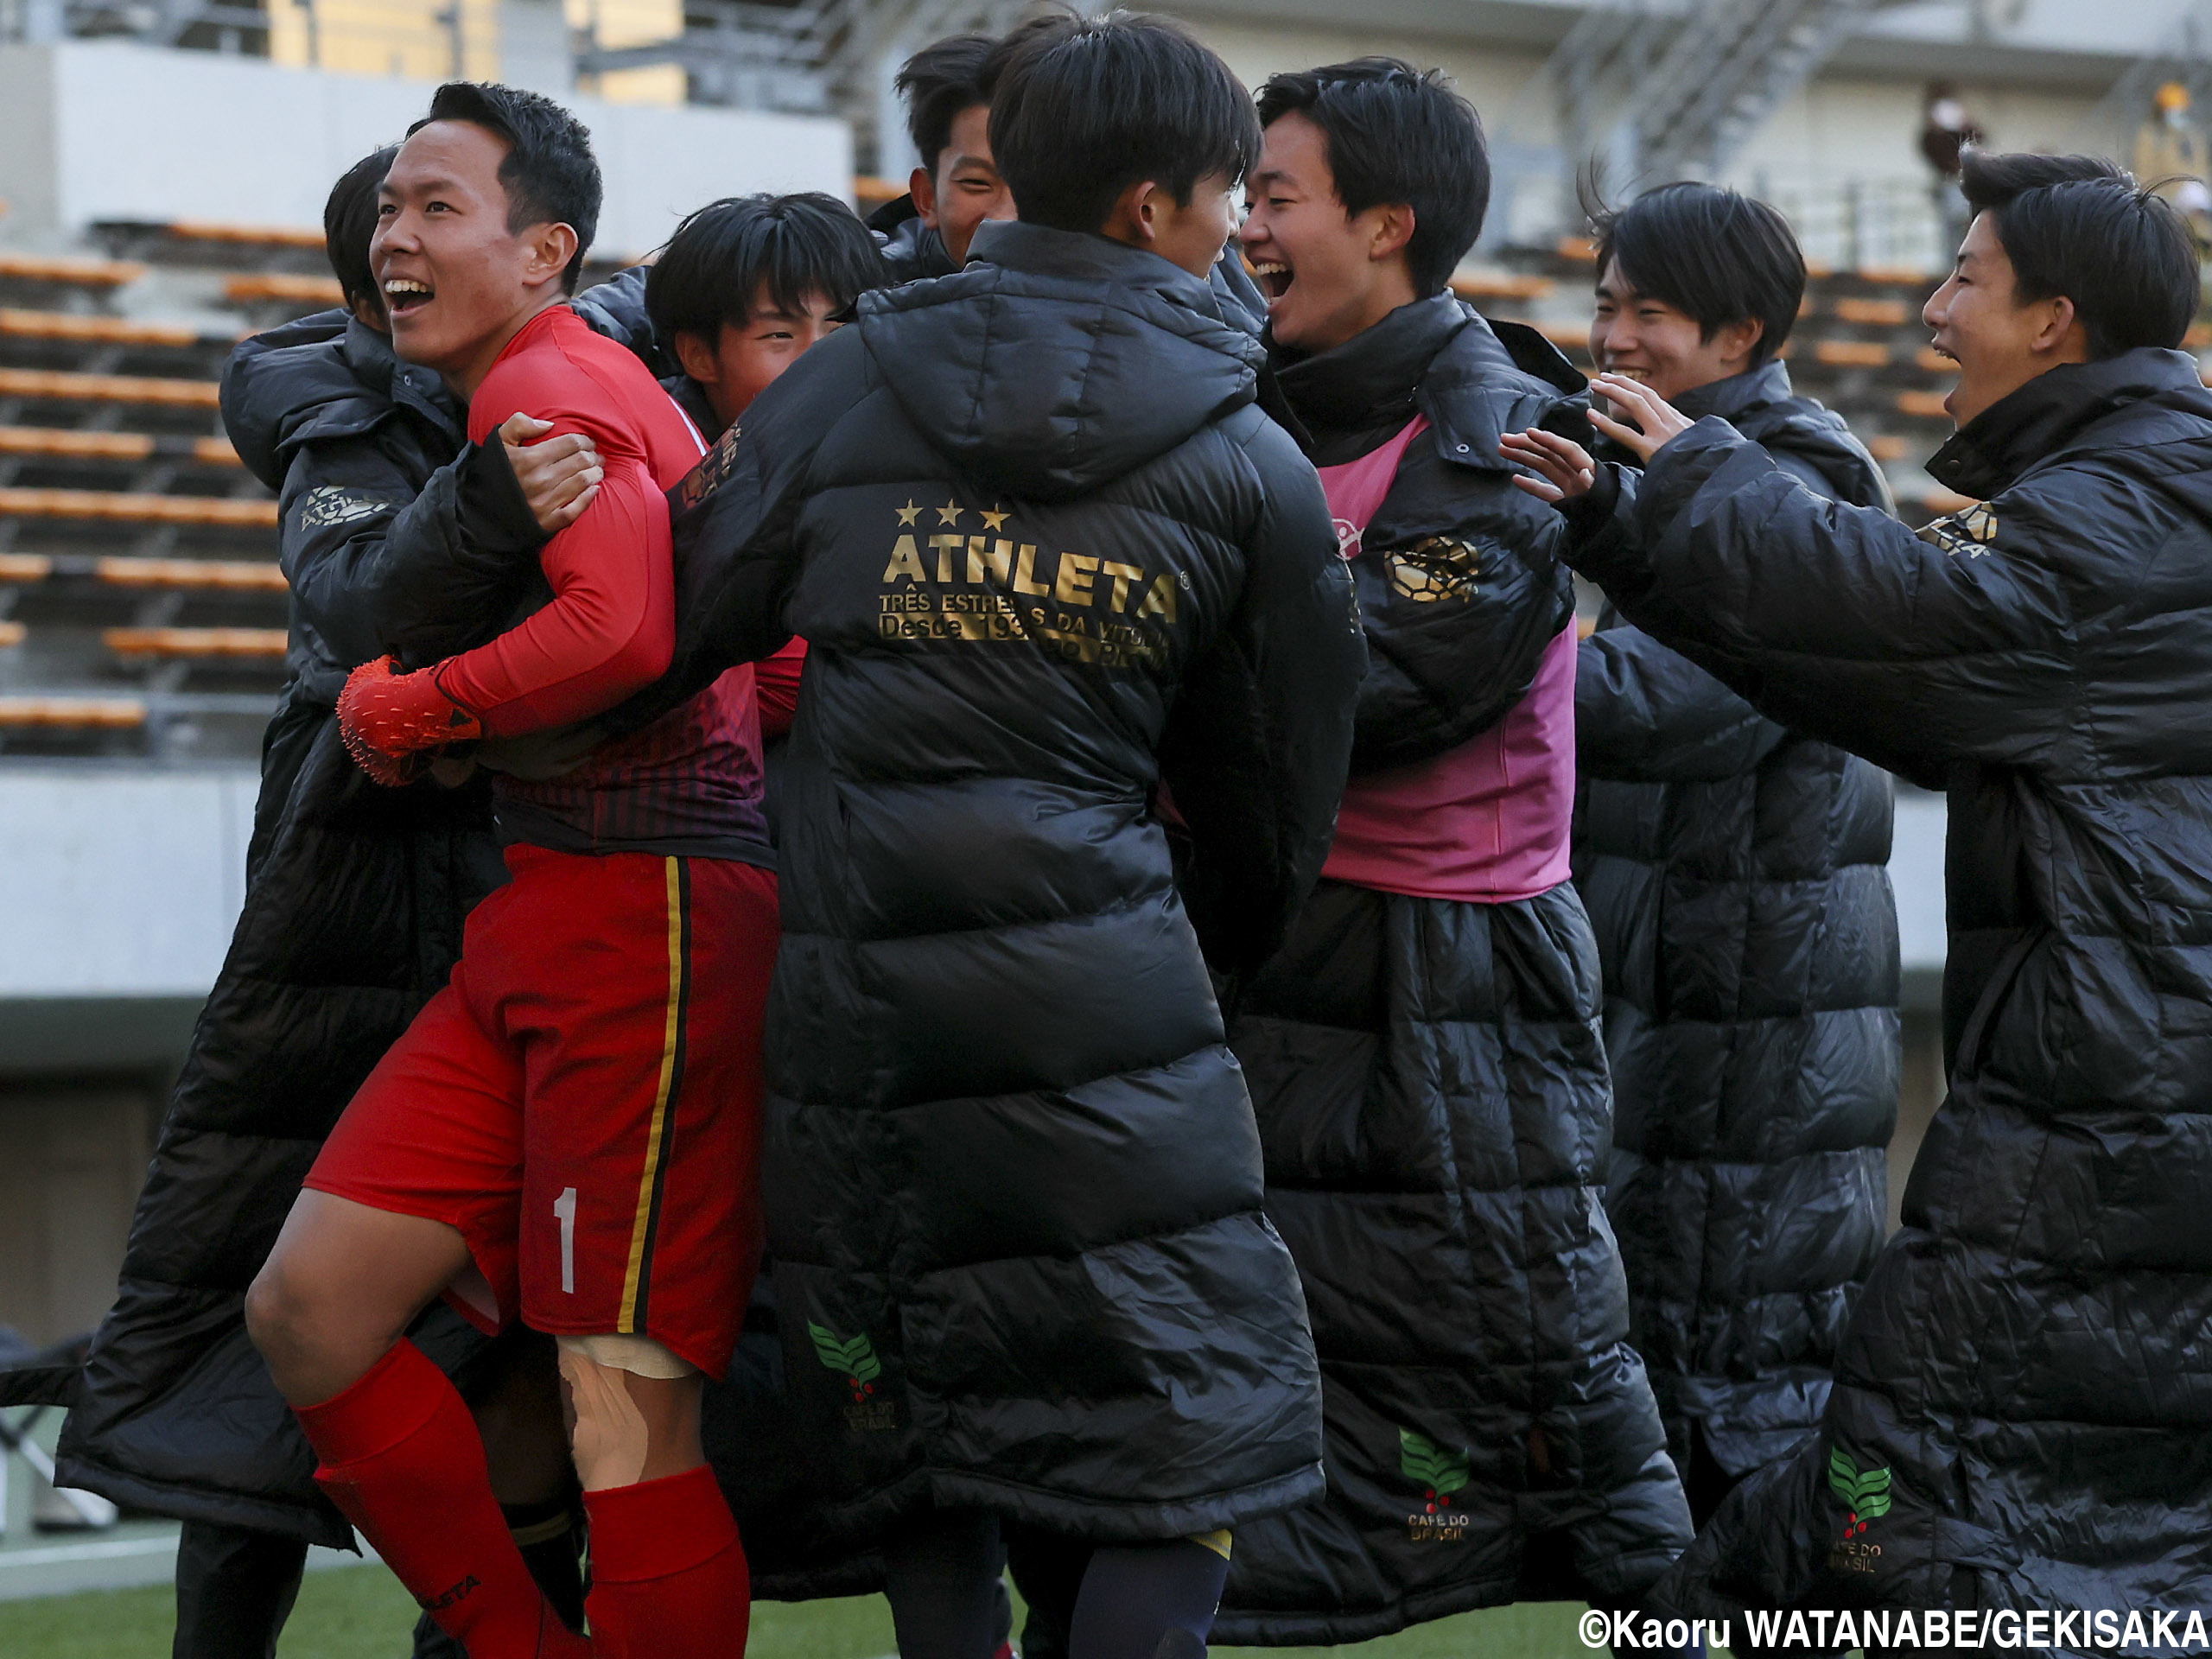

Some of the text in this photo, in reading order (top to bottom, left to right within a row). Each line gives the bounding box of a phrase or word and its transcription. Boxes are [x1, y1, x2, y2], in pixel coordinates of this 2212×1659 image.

[882, 534, 1178, 624] ATHLETA
[880, 583, 931, 612] TRÊS
[1057, 612, 1087, 633] DA
[881, 614, 962, 638] Desde
[554, 1187, 576, 1294] 1
[1449, 1515, 1469, 1526] DO
[1860, 1543, 1882, 1556] DO
